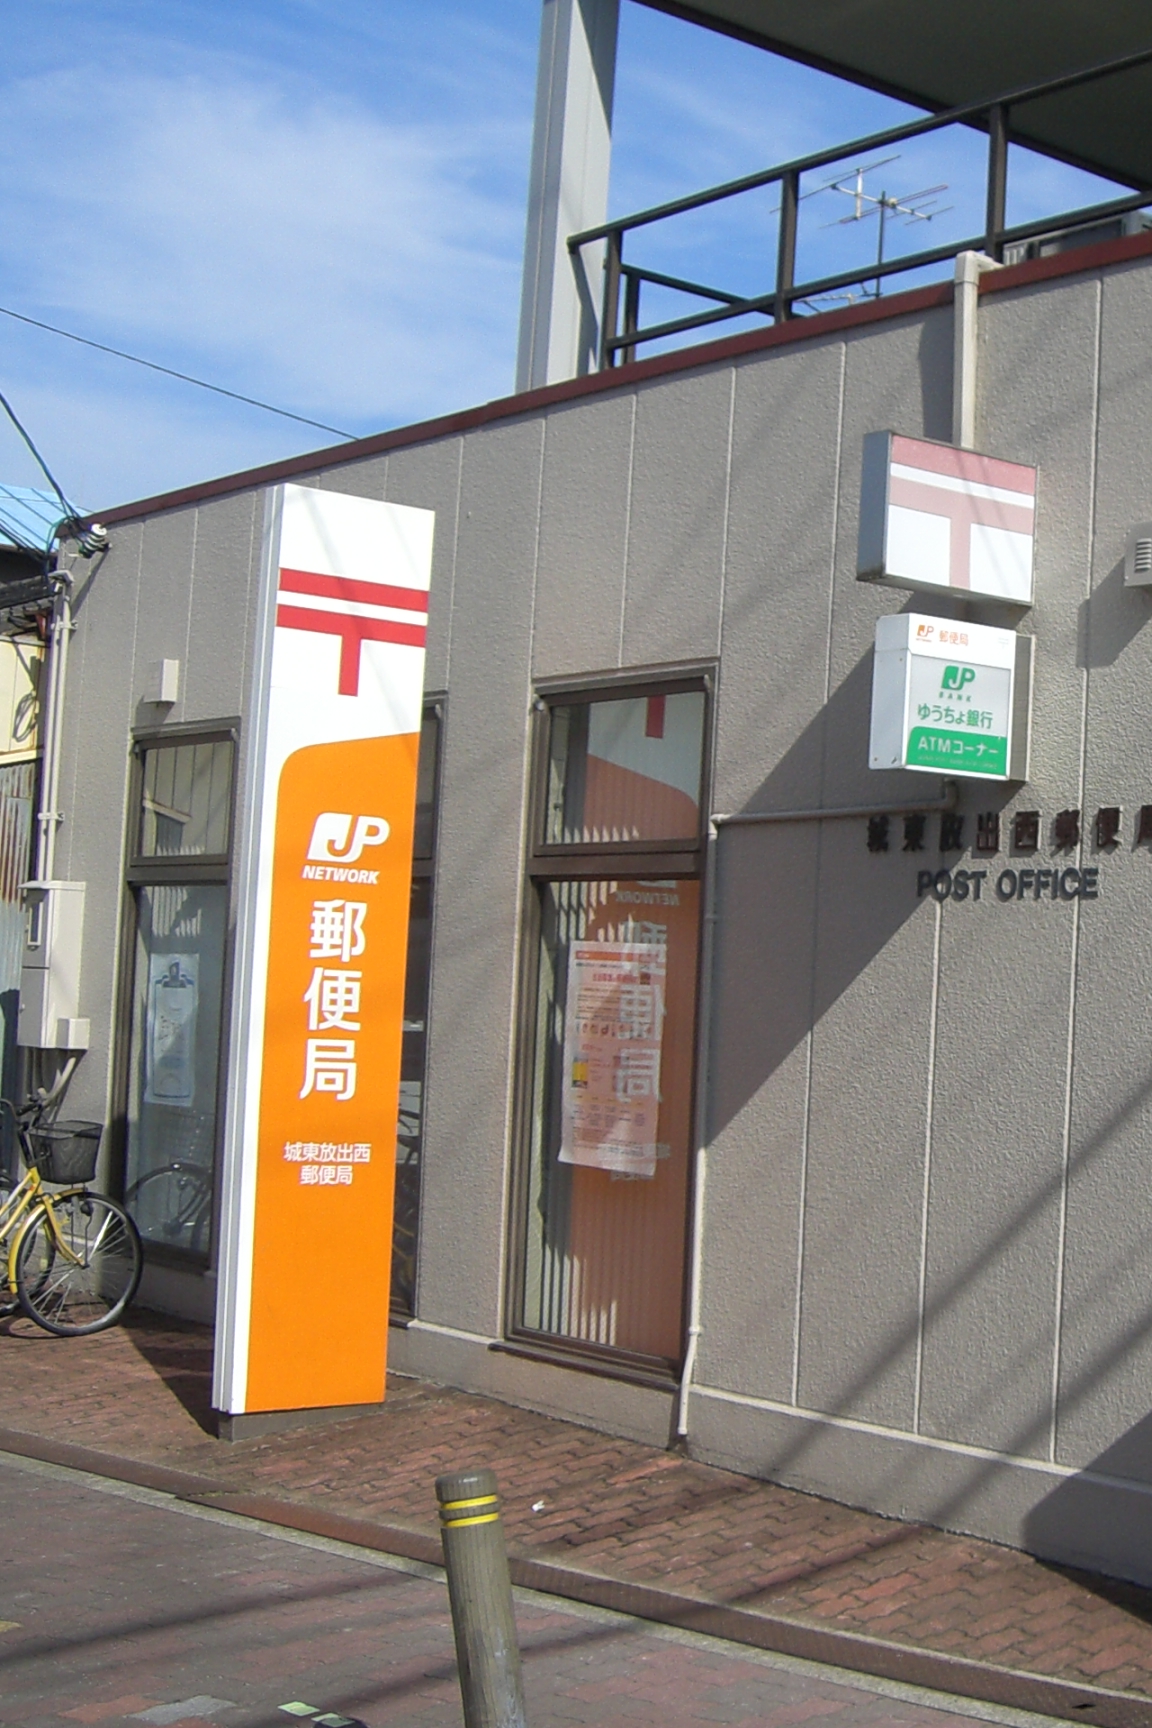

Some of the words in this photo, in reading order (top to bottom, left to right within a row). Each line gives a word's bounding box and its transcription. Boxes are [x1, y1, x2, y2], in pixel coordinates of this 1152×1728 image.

[917, 624, 934, 637] JP
[939, 630, 969, 647] 郵便局
[941, 665, 976, 691] JP
[938, 691, 972, 703] BANK
[917, 703, 993, 729] ゆうちょ銀行
[917, 736, 999, 757] ATMコーナー
[307, 812, 390, 864] JP
[302, 865, 380, 885] NETWORK
[916, 869, 988, 899] POST
[996, 867, 1100, 901] OFFICE
[299, 899, 368, 1102] 郵便局
[284, 1141, 371, 1163] 城東放出西
[300, 1165, 353, 1186] 郵便局
